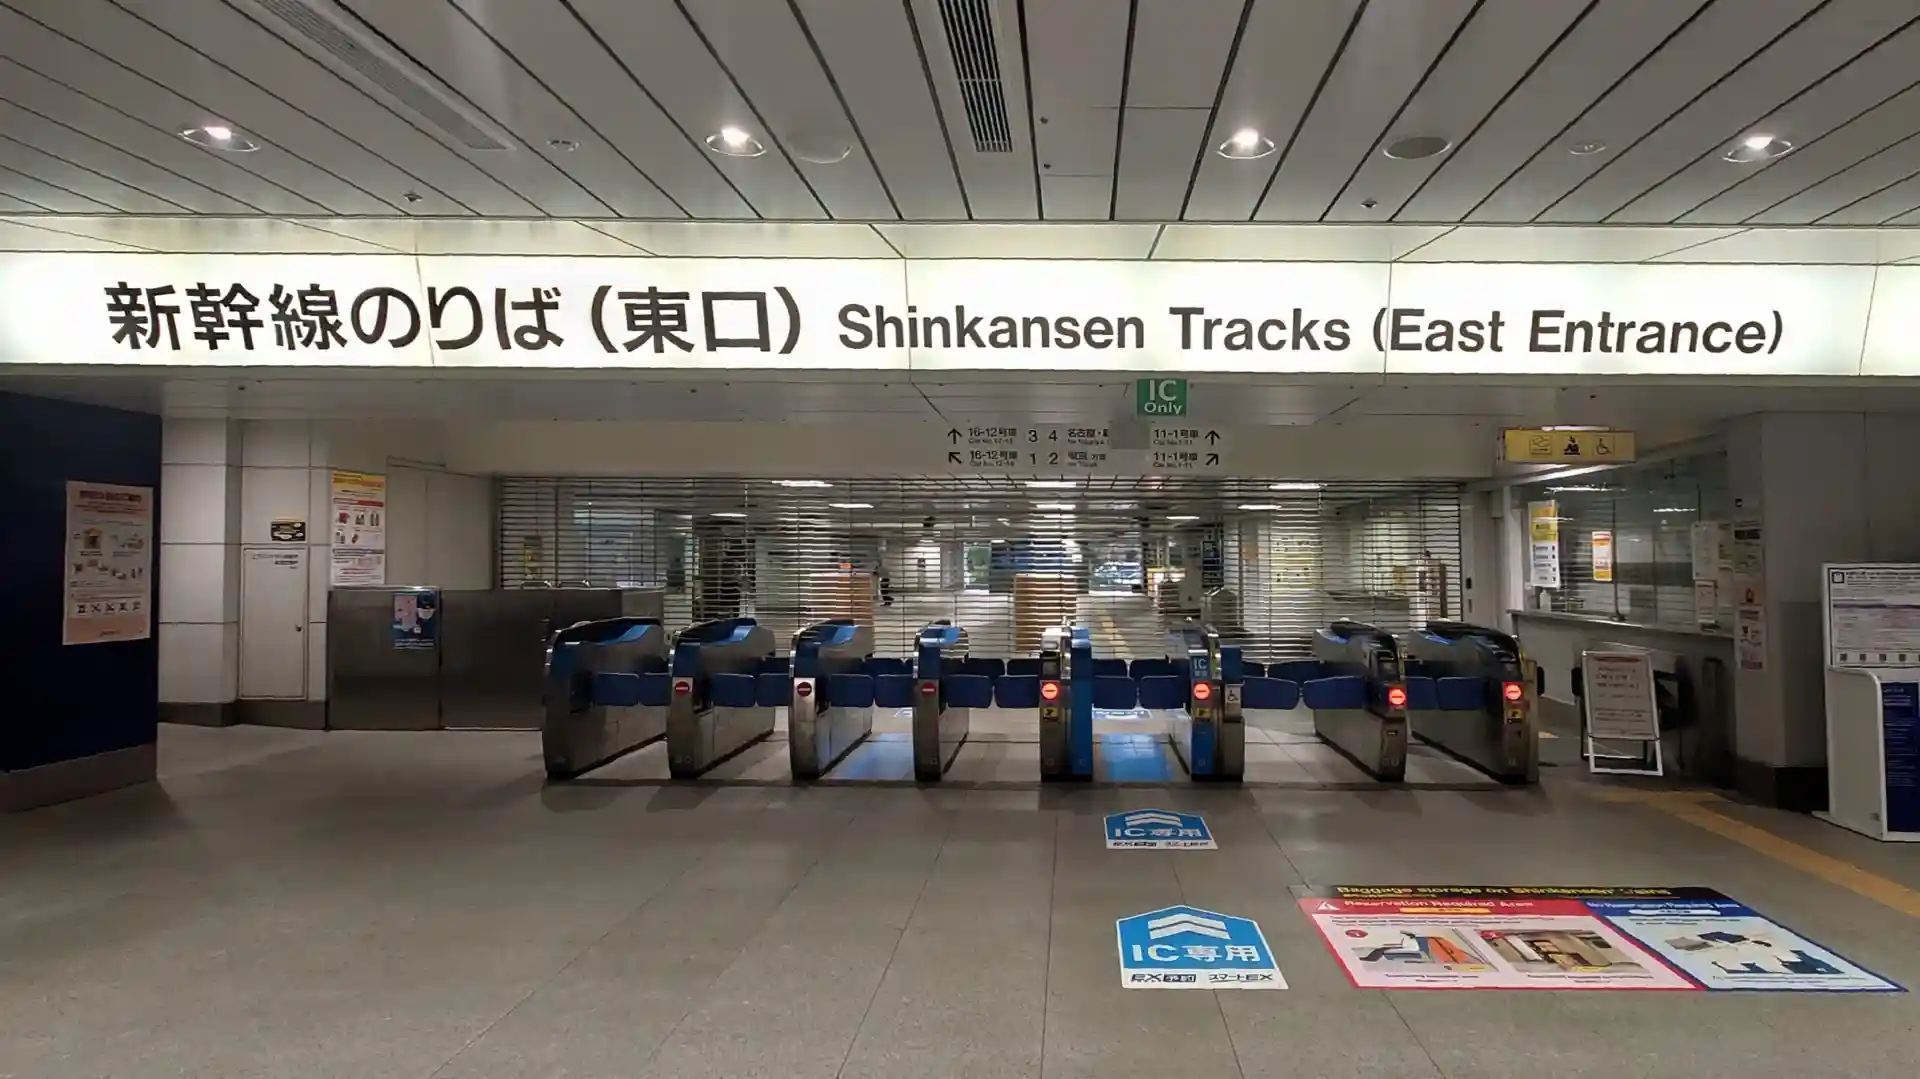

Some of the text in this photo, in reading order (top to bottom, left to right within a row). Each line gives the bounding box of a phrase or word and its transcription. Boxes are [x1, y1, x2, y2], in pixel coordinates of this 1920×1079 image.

[838, 303, 1783, 355] Shinkansen Tracks (East Entrance)
[1149, 379, 1178, 401] IC
[1144, 402, 1183, 415] Only
[1027, 429, 1039, 443] 3
[1048, 429, 1059, 442] 4
[1029, 452, 1037, 465] 1
[1048, 451, 1059, 465] 2
[1194, 657, 1208, 670] IC
[1131, 943, 1261, 963] IC専用
